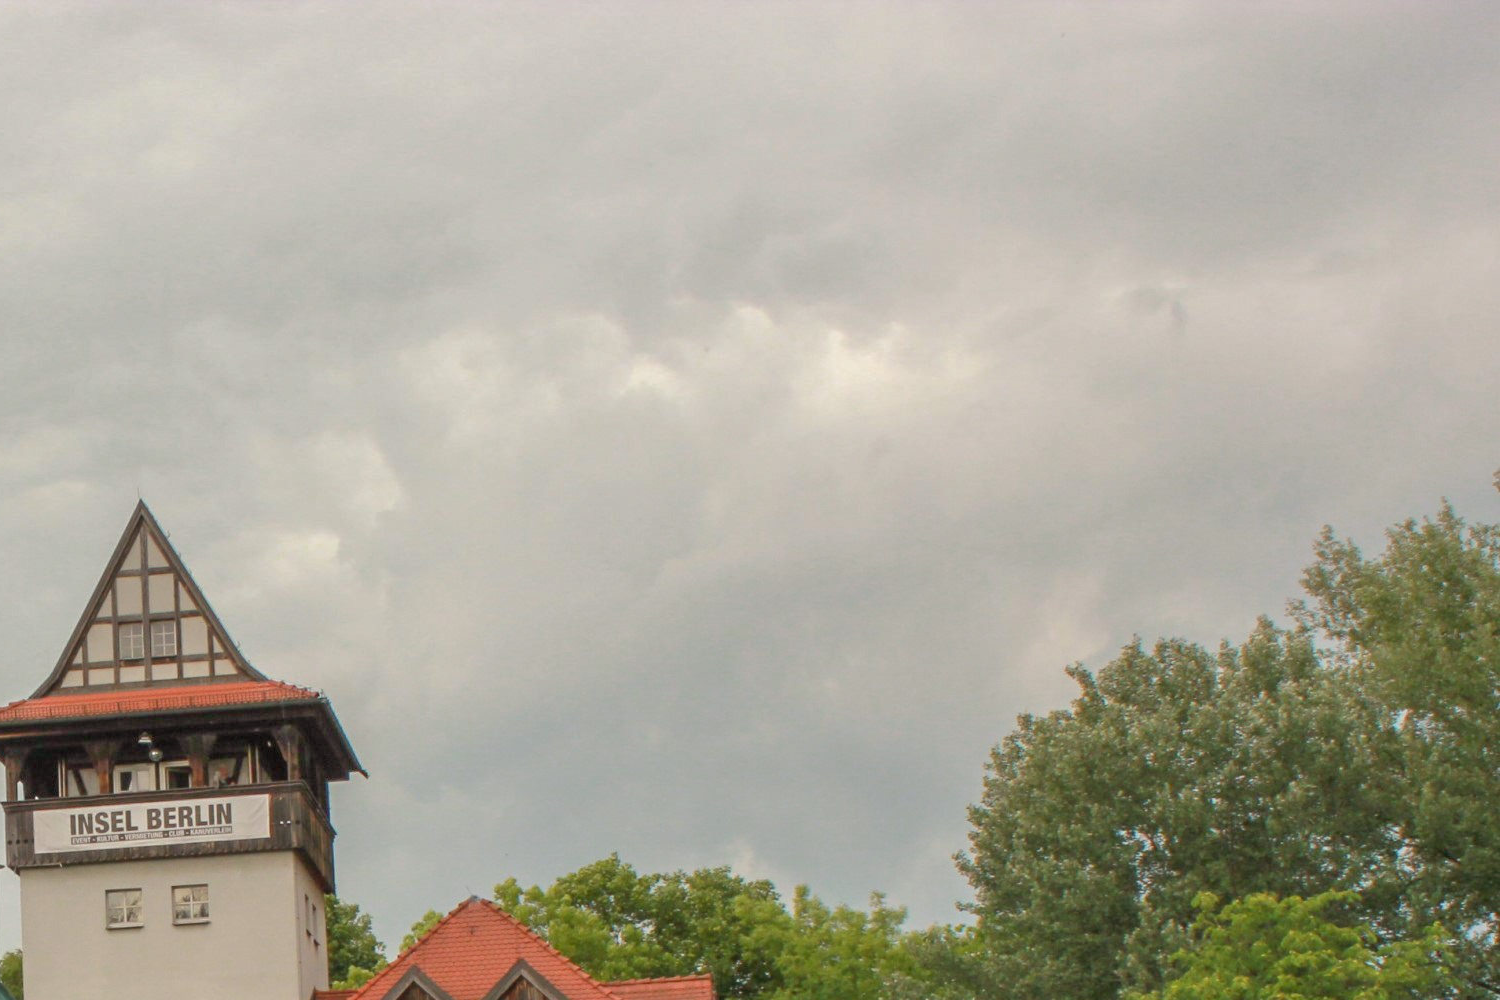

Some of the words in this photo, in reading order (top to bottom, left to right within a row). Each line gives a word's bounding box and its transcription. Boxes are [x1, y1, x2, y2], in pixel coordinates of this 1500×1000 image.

[70, 810, 139, 836] INSEL
[146, 803, 232, 830] BERLIN
[73, 836, 91, 845] EVENT
[96, 834, 119, 843] KULTUR
[124, 831, 163, 842] VERMIETUNG
[168, 829, 185, 837] CLUB
[190, 826, 232, 836] KANUVERLEIH
